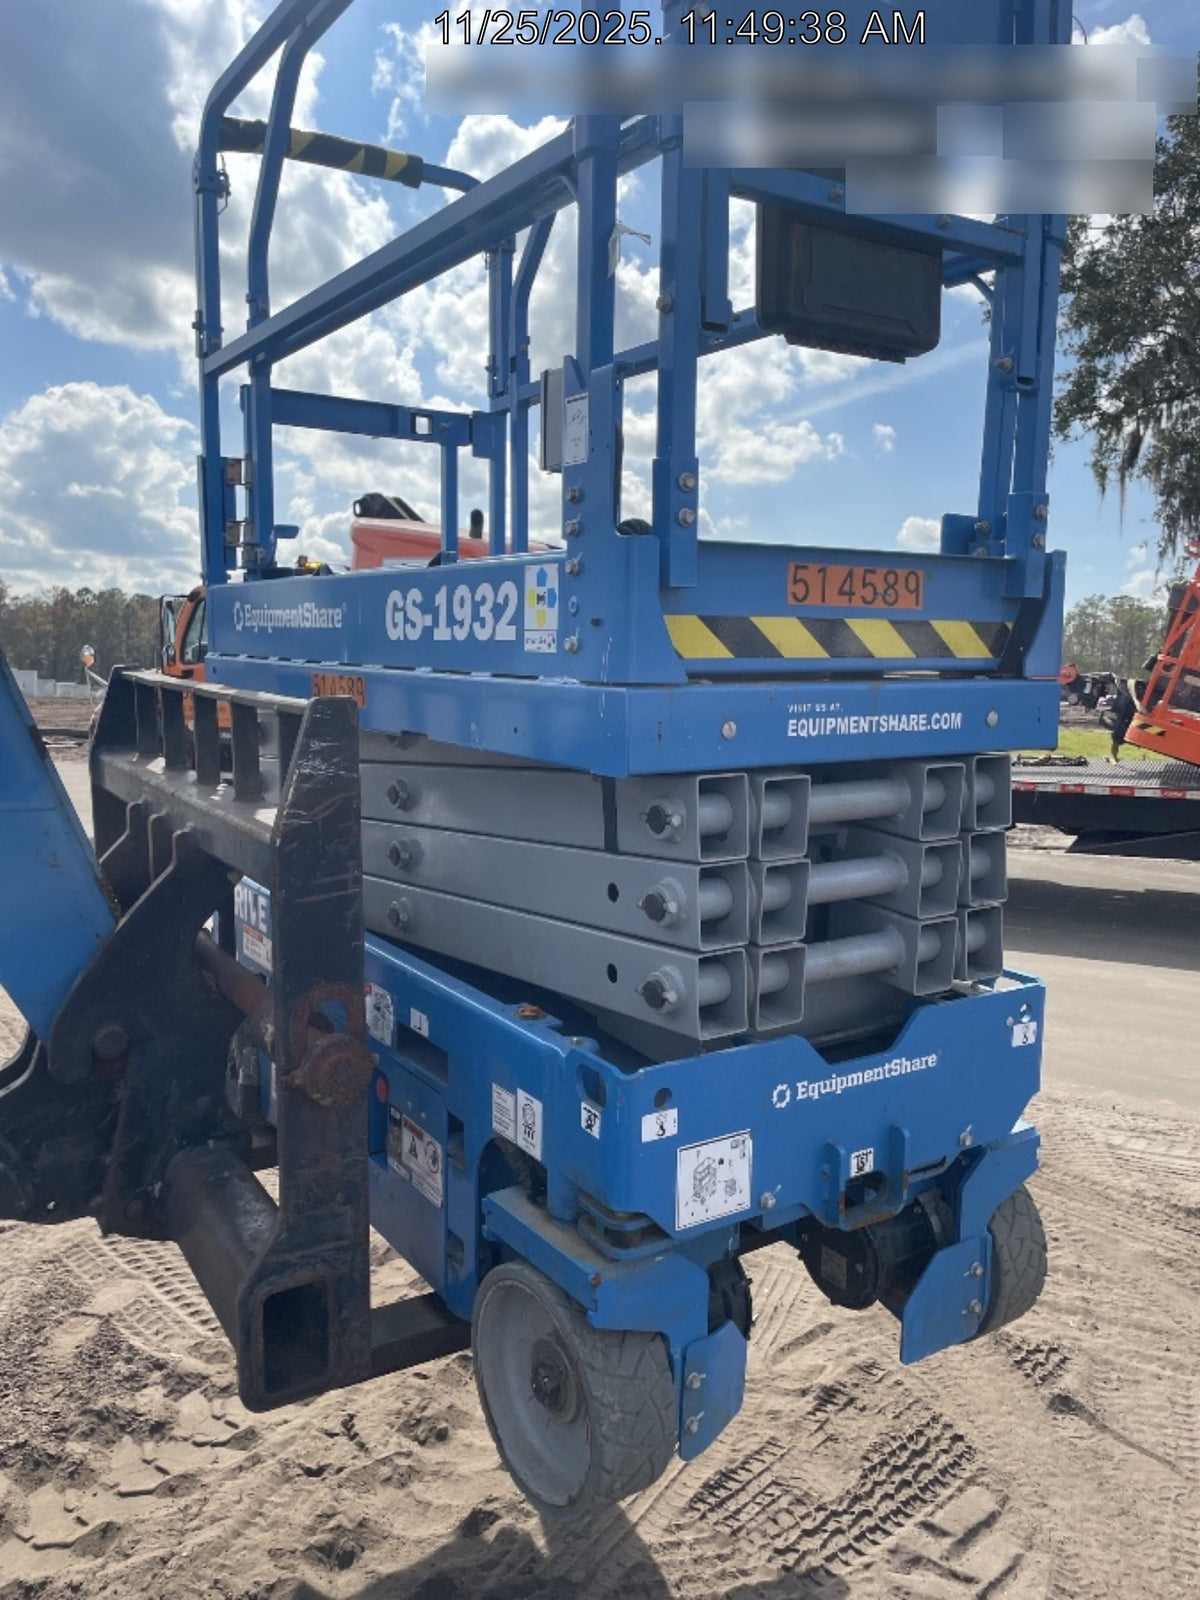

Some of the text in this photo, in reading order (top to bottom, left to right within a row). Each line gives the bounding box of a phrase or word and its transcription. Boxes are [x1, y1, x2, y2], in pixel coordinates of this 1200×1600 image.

[790, 565, 922, 607] 514589
[244, 602, 342, 634] EquipmentShare
[385, 580, 518, 641] GS-1932
[787, 713, 962, 738] EQUIPMENTSHARE.COM
[796, 1053, 938, 1101] EquipmentShare
